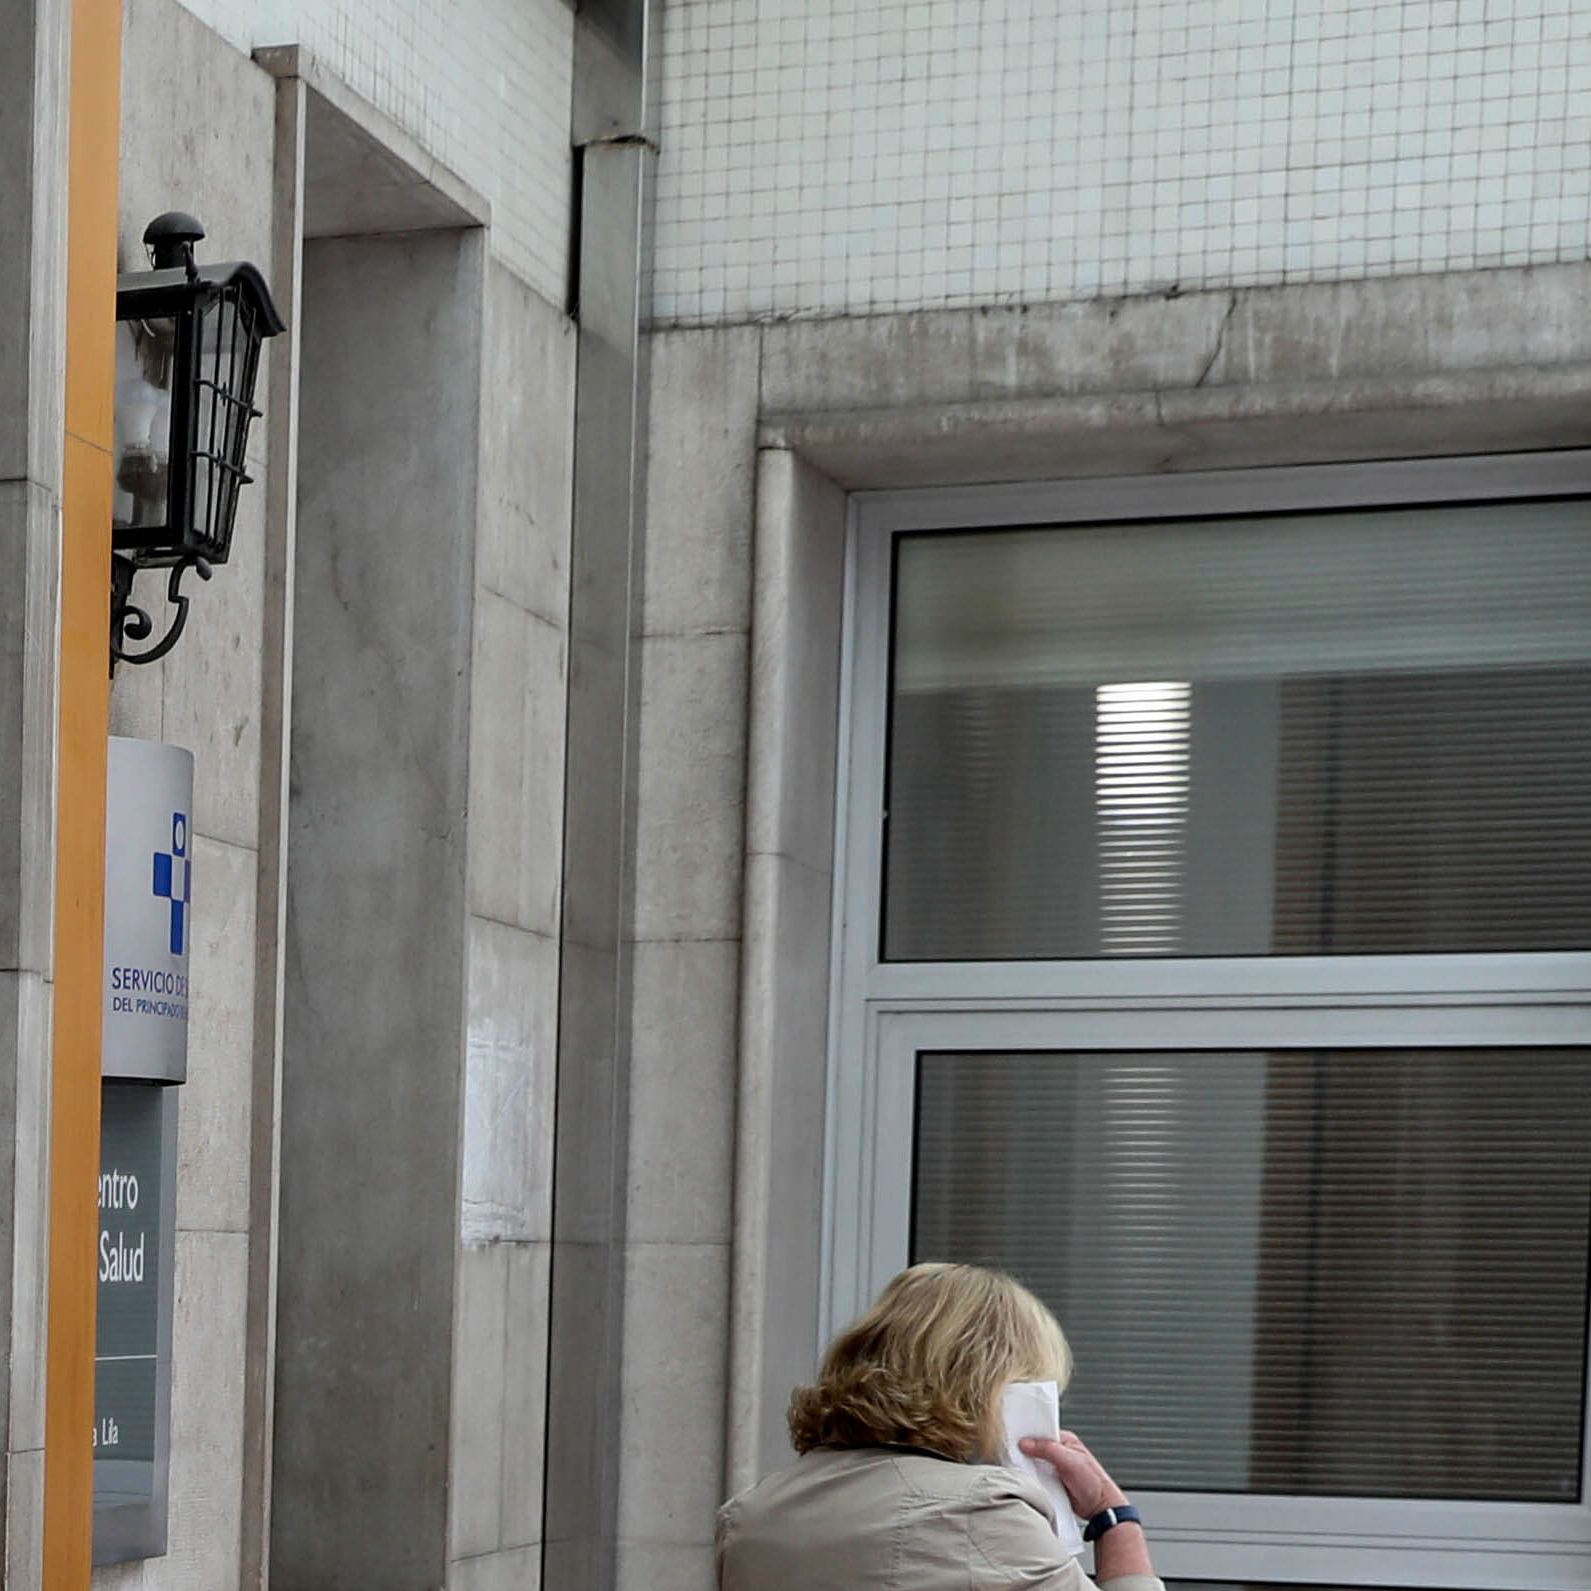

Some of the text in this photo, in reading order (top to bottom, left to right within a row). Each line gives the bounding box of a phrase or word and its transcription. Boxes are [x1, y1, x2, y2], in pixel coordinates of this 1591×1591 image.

[112, 966, 174, 994] SERVICIO
[113, 996, 133, 1012] DEL
[99, 1229, 145, 1283] Salud
